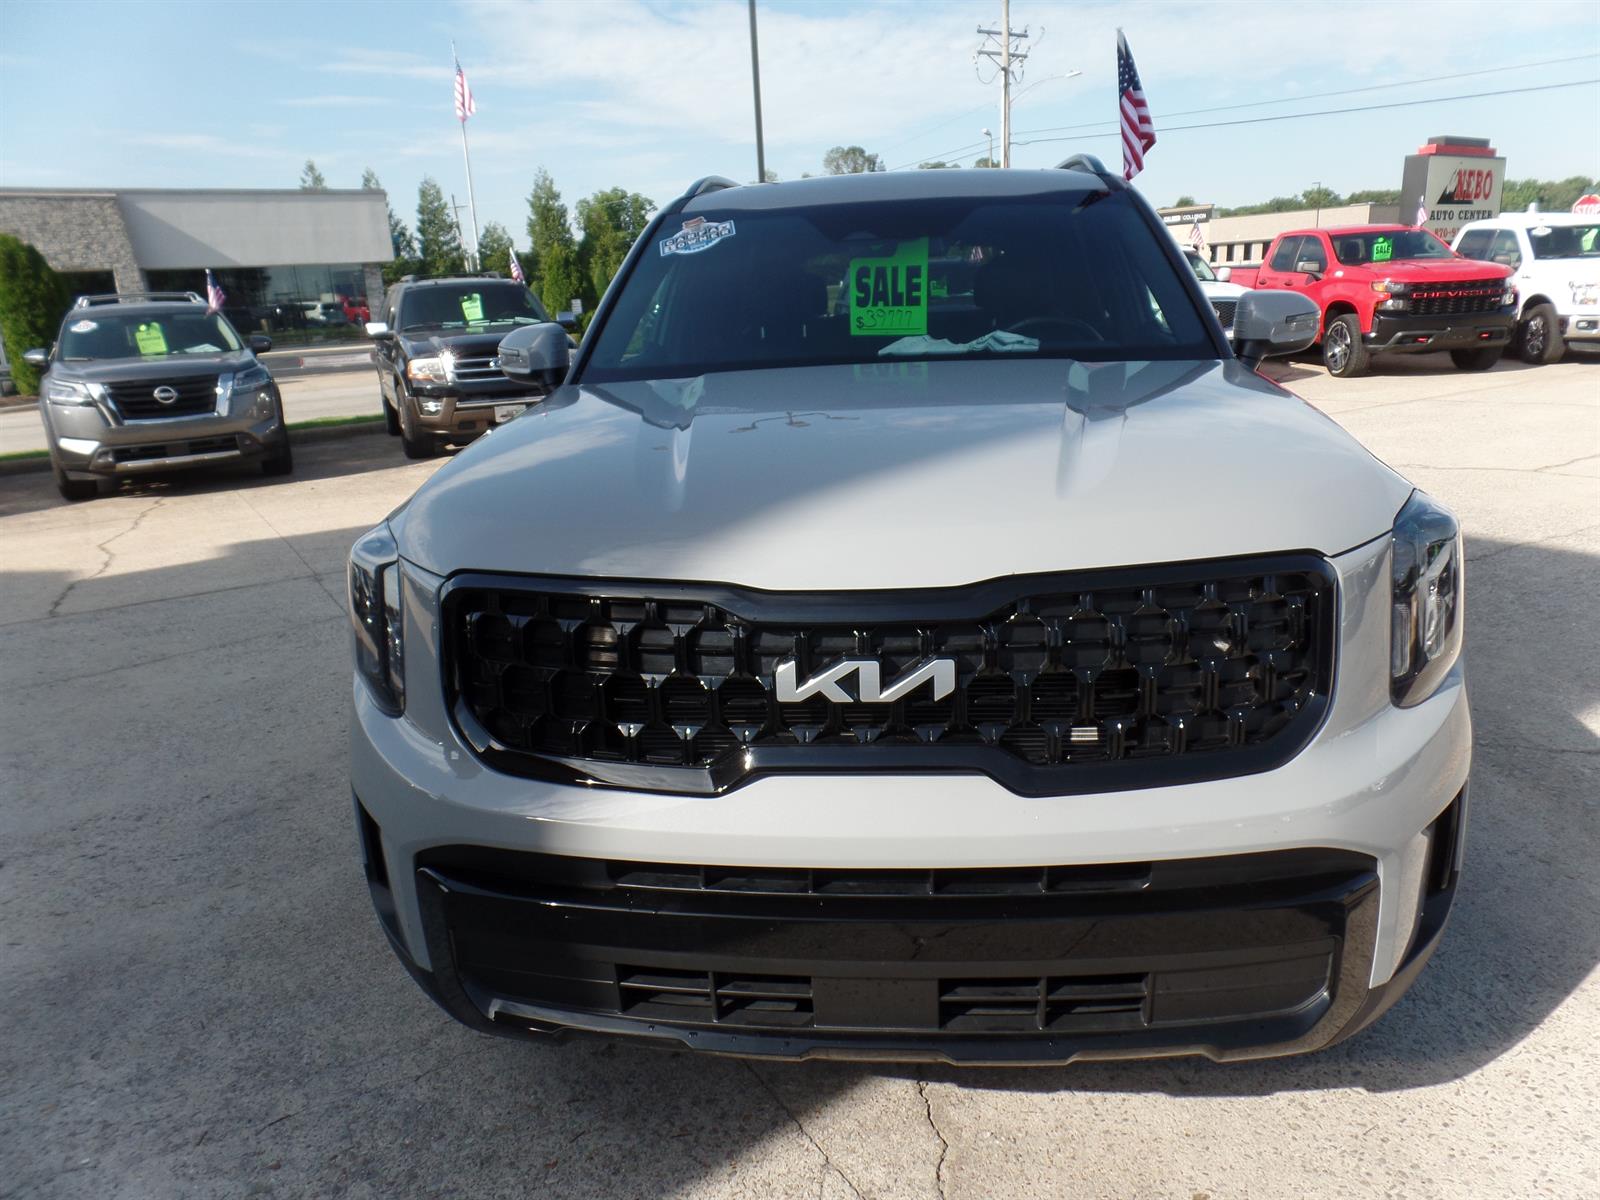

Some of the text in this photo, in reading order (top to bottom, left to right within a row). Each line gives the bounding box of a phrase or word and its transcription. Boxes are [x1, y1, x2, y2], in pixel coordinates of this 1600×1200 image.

[1455, 168, 1493, 200] NEBO
[1430, 210, 1493, 220] AUTO CENTER
[1375, 245, 1391, 254] SALE
[856, 265, 922, 307] SALE
[776, 659, 955, 703] KIA
